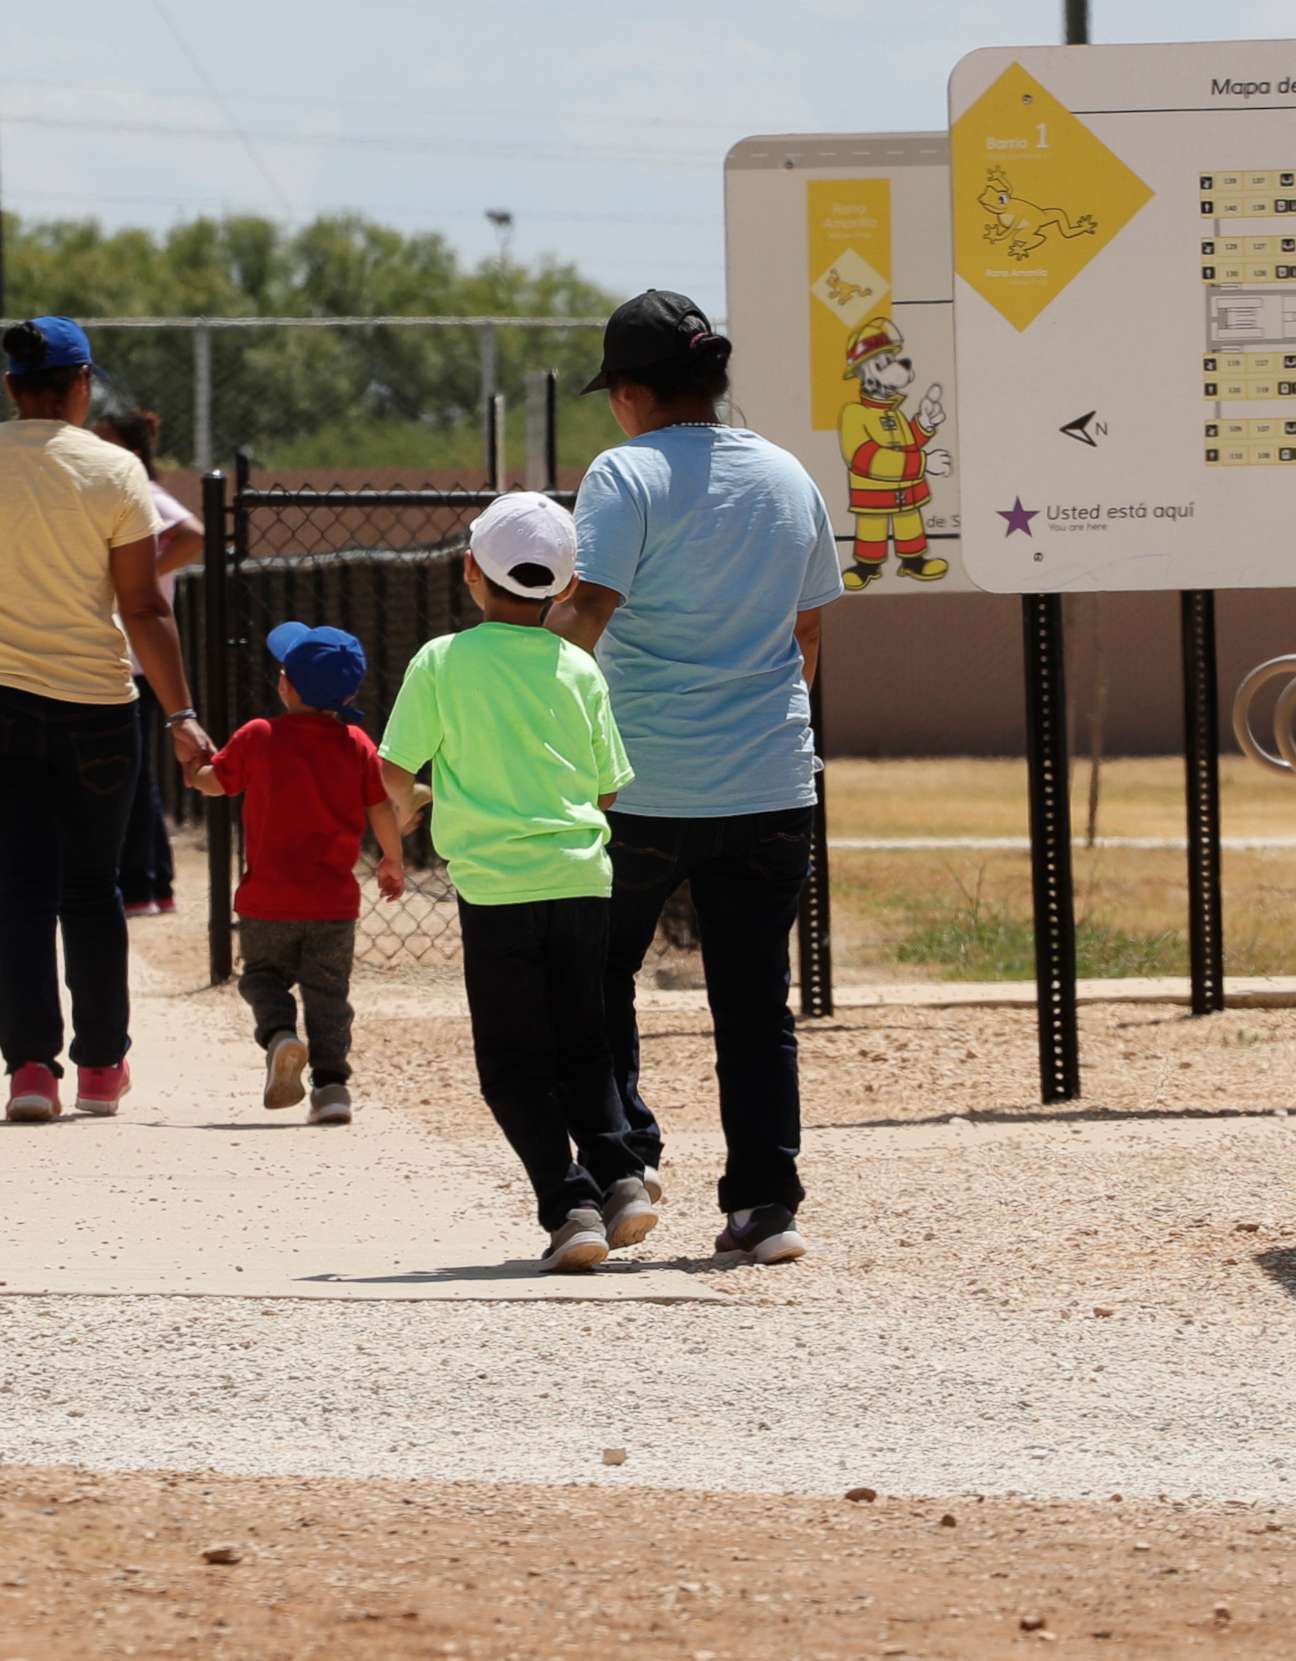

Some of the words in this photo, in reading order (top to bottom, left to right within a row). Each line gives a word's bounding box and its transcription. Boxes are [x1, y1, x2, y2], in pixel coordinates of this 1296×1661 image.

[1211, 78, 1270, 99] Mapa
[1035, 122, 1049, 149] 1
[1095, 422, 1108, 436] N
[1046, 504, 1101, 520] Usted
[1106, 502, 1148, 519] está
[1152, 501, 1195, 521] aquí
[927, 514, 945, 528] de
[1048, 523, 1066, 532] You
[1068, 523, 1084, 532] are
[1086, 522, 1107, 532] here
